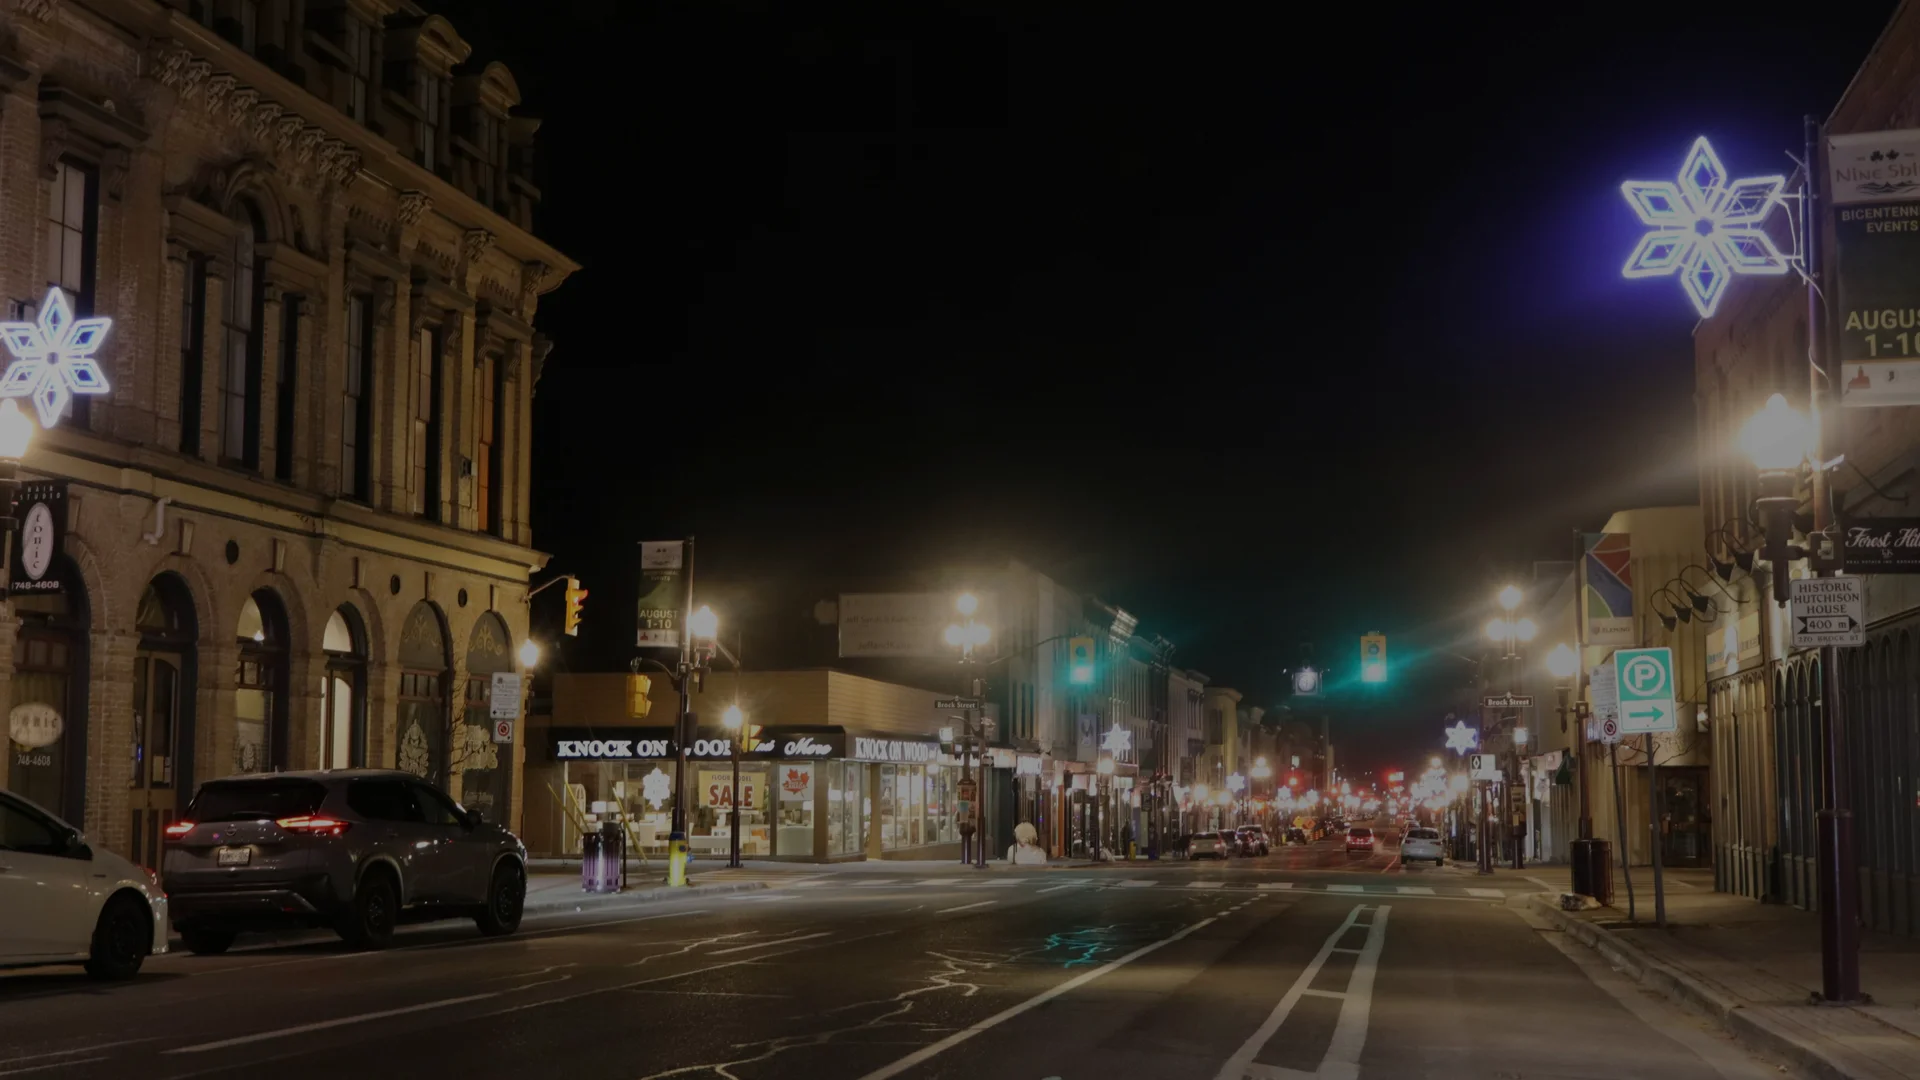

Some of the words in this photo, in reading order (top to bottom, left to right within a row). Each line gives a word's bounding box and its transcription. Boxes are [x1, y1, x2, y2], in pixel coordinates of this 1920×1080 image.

[1842, 205, 1920, 221] BICENTENN
[1866, 220, 1919, 233] EVENTS
[1845, 309, 1920, 331] AUGU
[1845, 526, 1893, 548] Forest
[1799, 582, 1853, 593] HISTORIC
[1794, 593, 1860, 604] HUTCHISON
[640, 609, 678, 618] AUGUST
[1807, 604, 1847, 614] HOUSE
[646, 620, 672, 629] 1-10
[1809, 620, 1832, 629] 400
[1488, 698, 1508, 706] Brock
[1509, 698, 1529, 706] Street
[557, 739, 632, 757] KNOCK
[637, 739, 668, 757] ON
[784, 737, 832, 756] More
[855, 737, 889, 760] KNOCK
[889, 741, 902, 761] ON
[903, 742, 928, 761] WOOD
